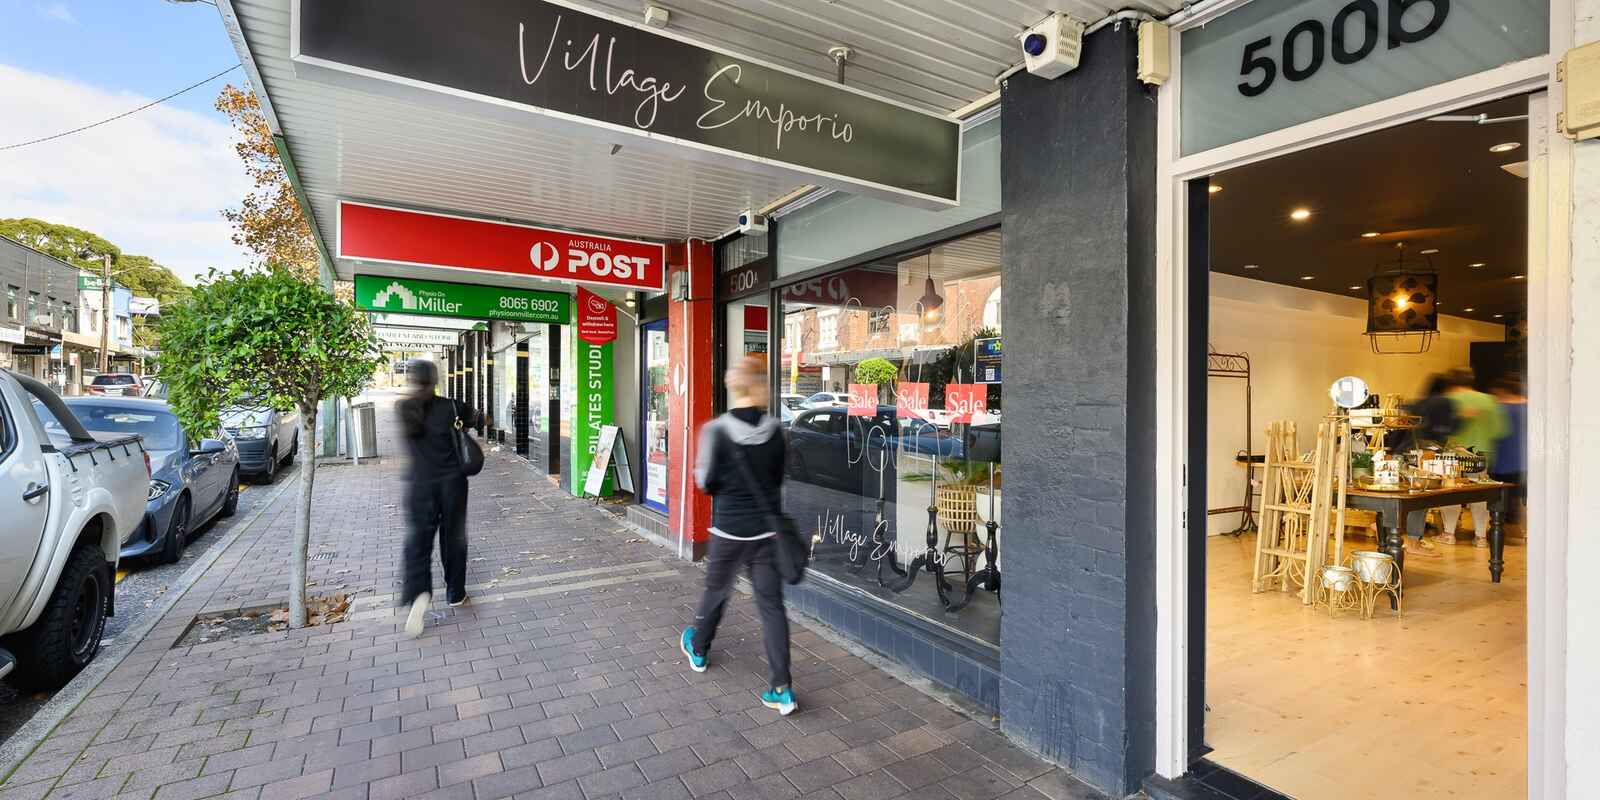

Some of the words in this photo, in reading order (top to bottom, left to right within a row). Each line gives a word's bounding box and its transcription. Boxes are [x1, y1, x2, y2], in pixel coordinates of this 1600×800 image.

[518, 15, 686, 129] Village
[697, 63, 853, 151] Emporio
[568, 239, 612, 251] AUSTRALIA
[568, 249, 650, 280] POST
[419, 297, 463, 313] Miller
[489, 309, 559, 321] physioonmiller.com.au
[500, 296, 528, 310] 8065
[531, 298, 559, 313] 6902
[588, 344, 602, 389] STUDI
[850, 388, 878, 409] Sale
[899, 388, 928, 409] Sale
[949, 391, 985, 415] Sale
[817, 508, 867, 562] Village
